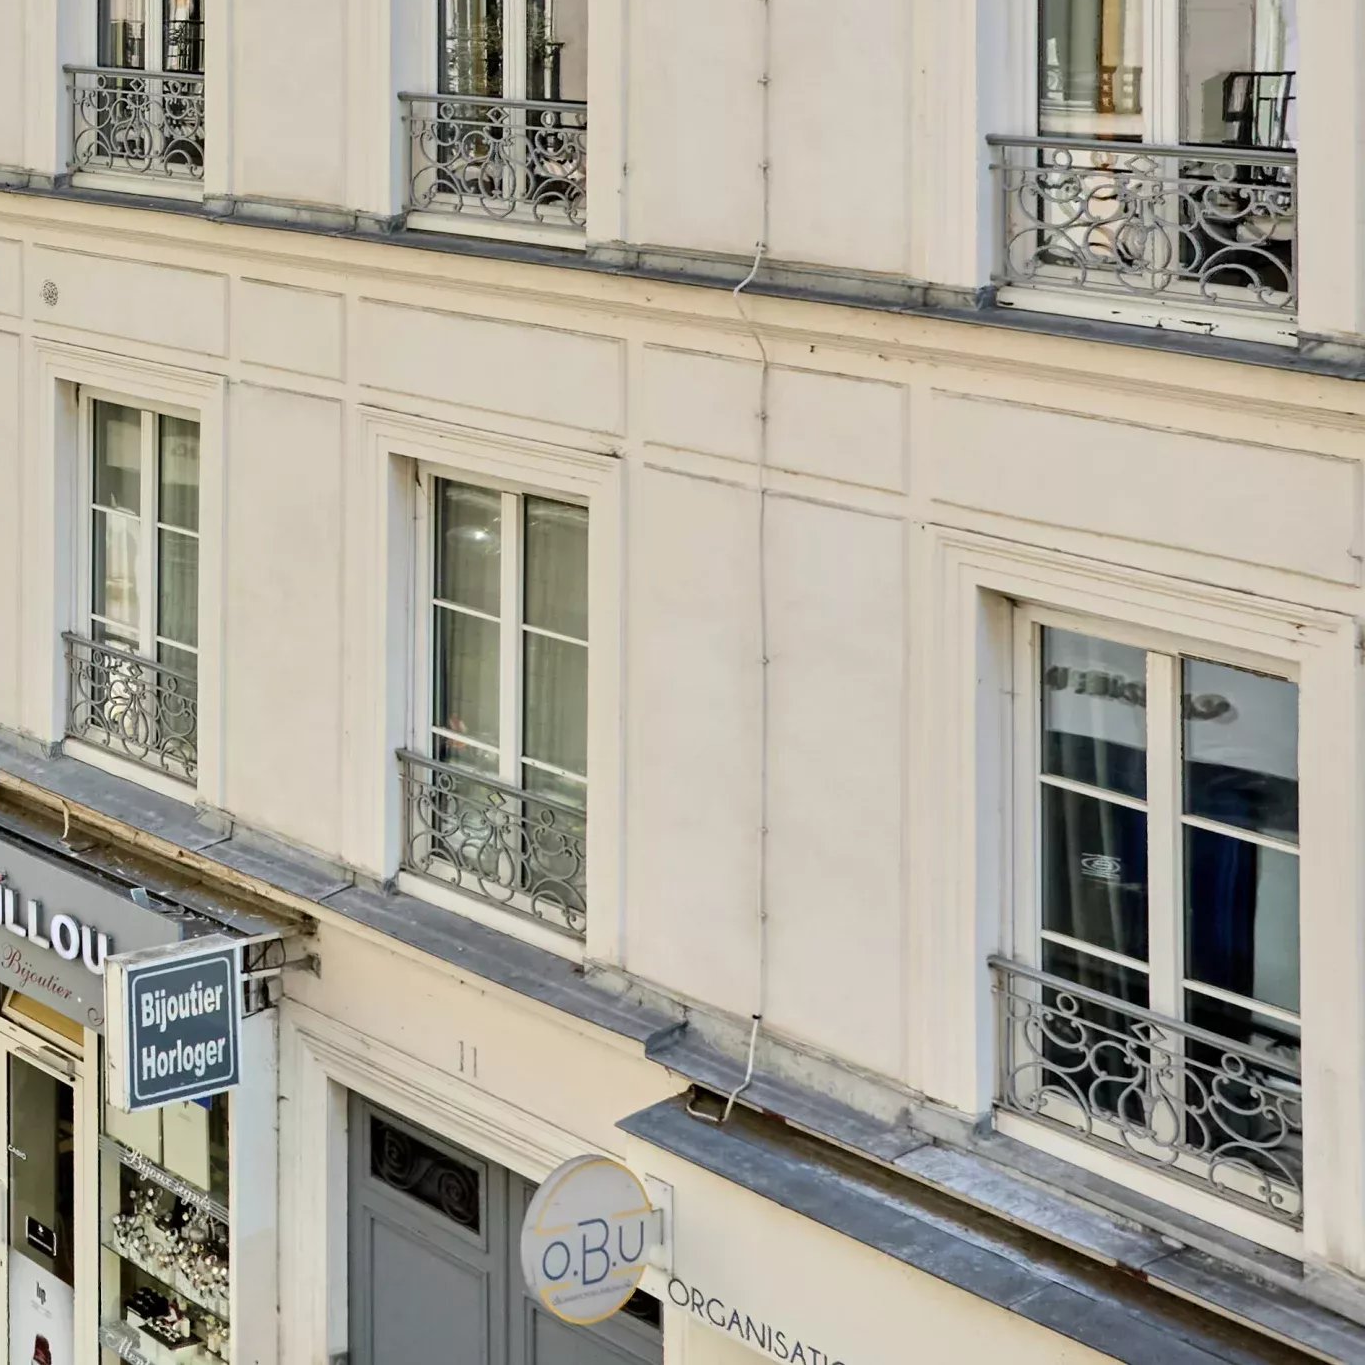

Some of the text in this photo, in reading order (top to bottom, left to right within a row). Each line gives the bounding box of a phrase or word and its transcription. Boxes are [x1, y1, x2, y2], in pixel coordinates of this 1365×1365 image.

[0, 937, 73, 1000] Bijoutier
[141, 981, 223, 1033] Bijoutier
[142, 1037, 226, 1081] Horloger
